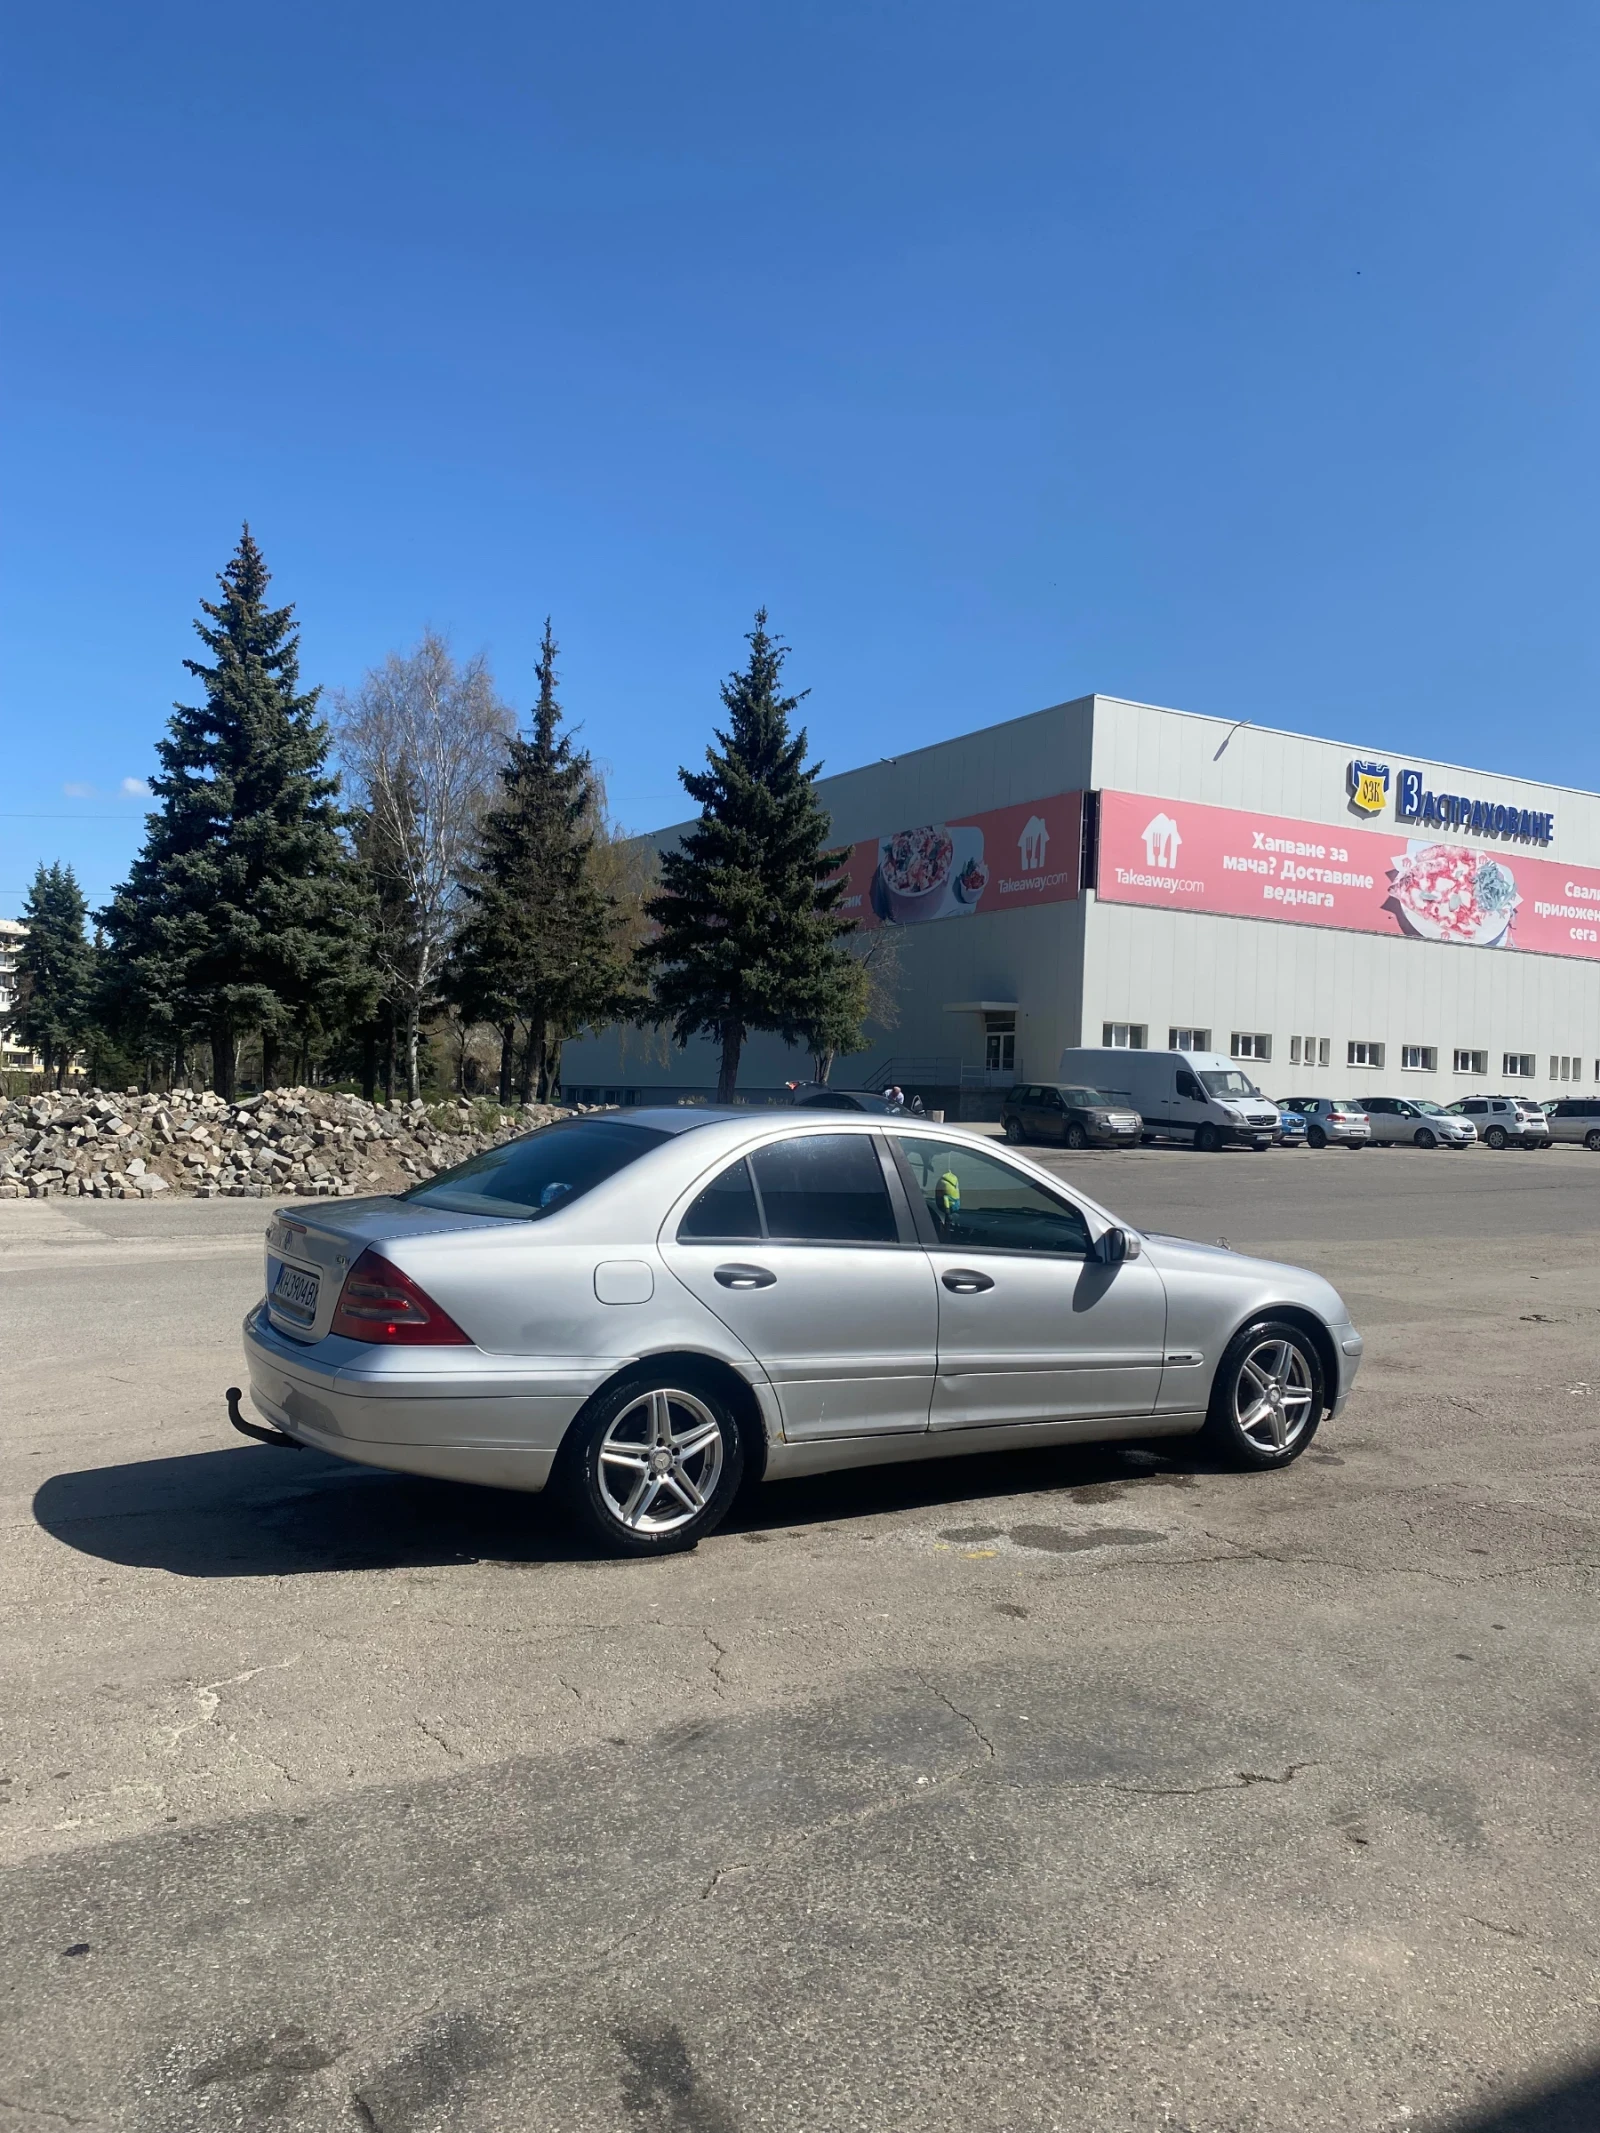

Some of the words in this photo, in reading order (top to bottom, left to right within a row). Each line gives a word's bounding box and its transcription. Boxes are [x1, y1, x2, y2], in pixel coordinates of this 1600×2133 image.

[1252, 832, 1326, 859] Хапване
[1329, 847, 1349, 862] за
[998, 872, 1068, 893] Takeaway.com
[1115, 868, 1205, 894] Takeaway.com
[1223, 855, 1277, 876] мача?
[1280, 860, 1375, 890] Доставяме
[1263, 884, 1335, 908] веднага
[1569, 927, 1598, 942] сега
